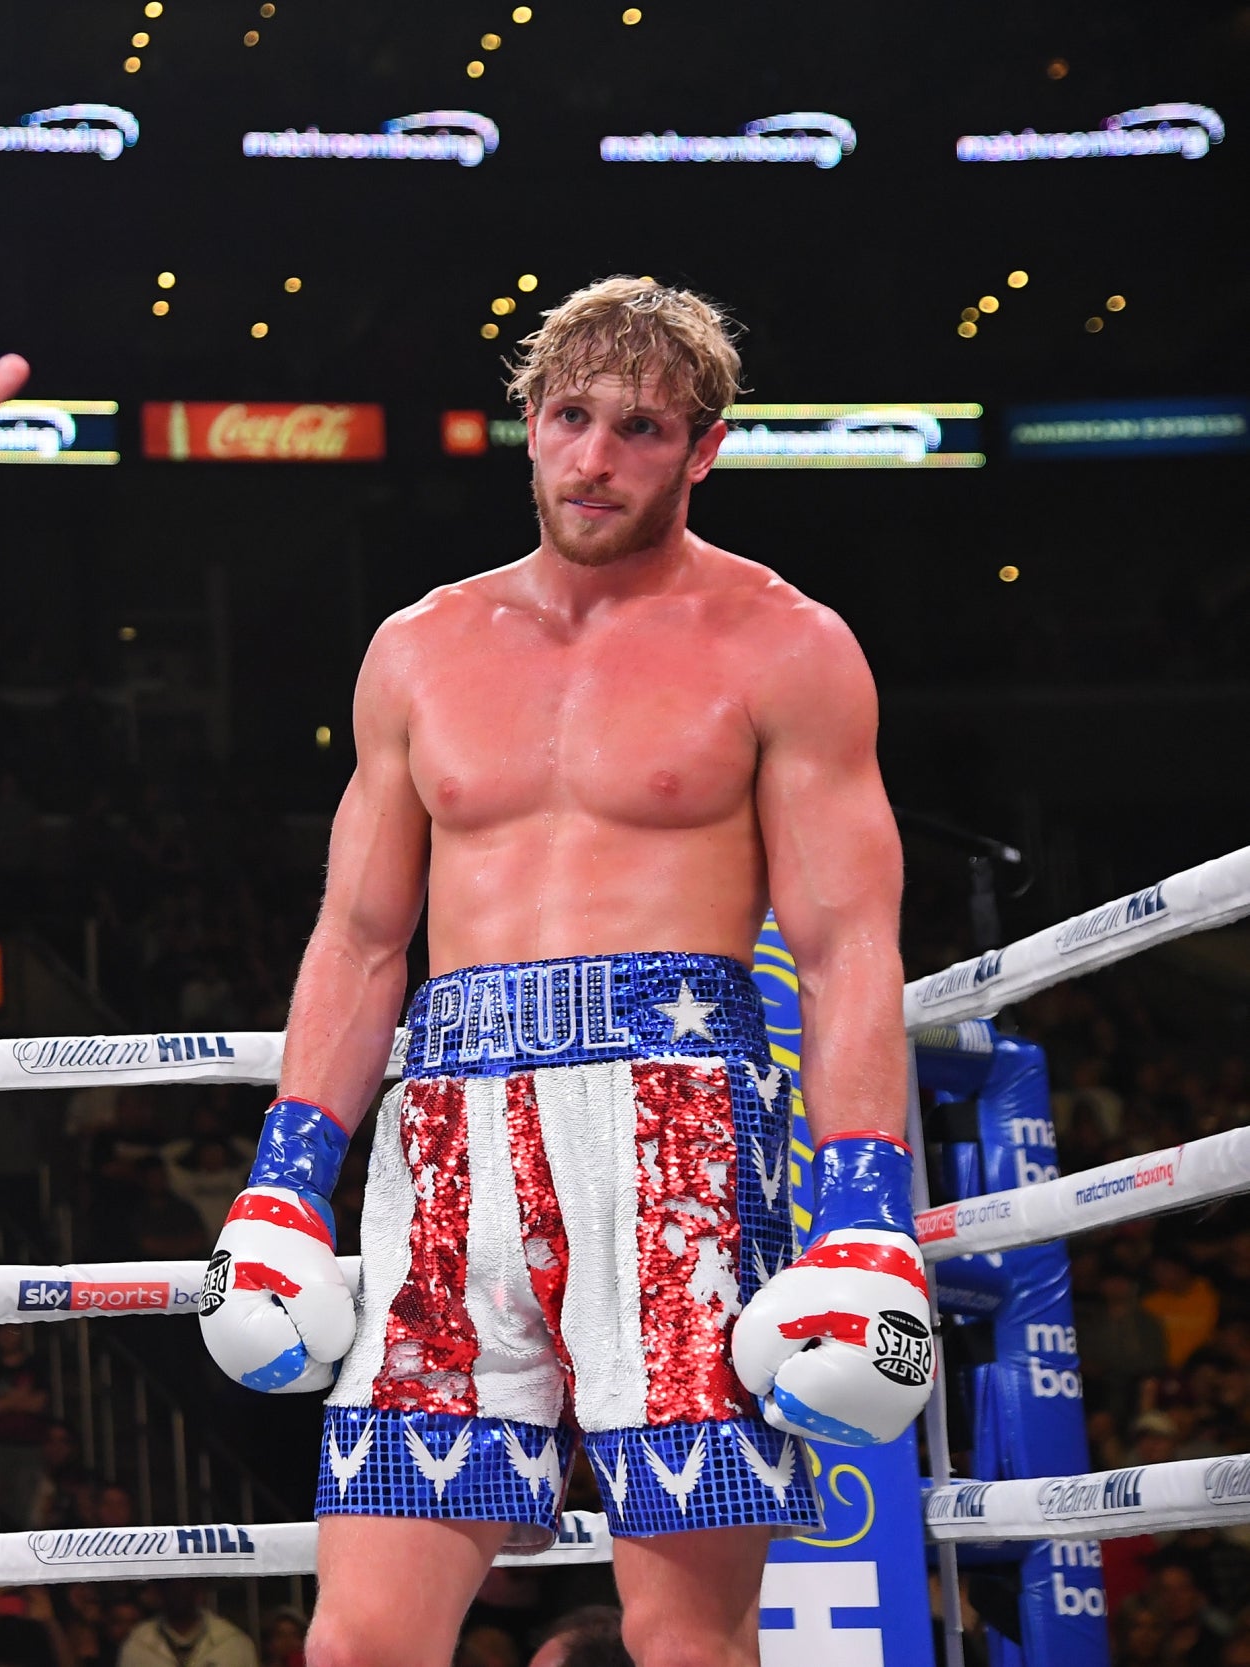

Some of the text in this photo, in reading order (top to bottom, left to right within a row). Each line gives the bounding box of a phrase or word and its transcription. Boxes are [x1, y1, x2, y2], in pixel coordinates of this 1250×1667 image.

[424, 961, 629, 1068] PAUL
[13, 1035, 235, 1073] William HILL
[25, 1283, 69, 1308] sky
[77, 1286, 163, 1308] sports
[875, 1323, 932, 1375] REYES
[878, 1359, 922, 1384] CLETO
[28, 1526, 255, 1562] William HILL
